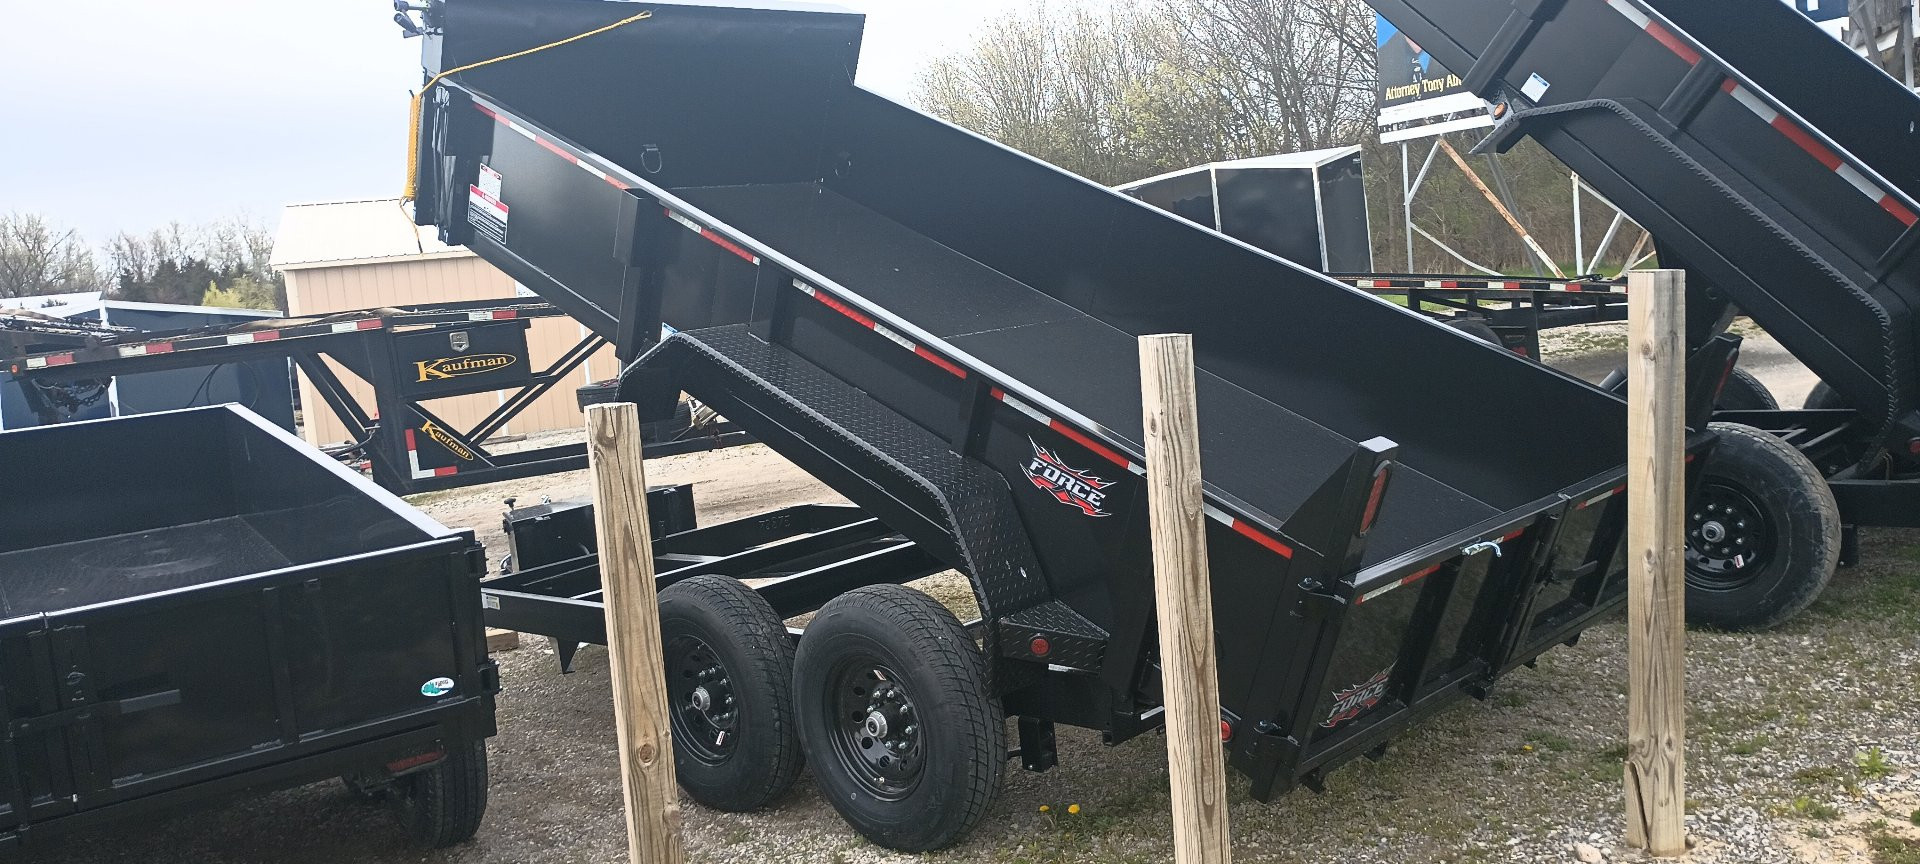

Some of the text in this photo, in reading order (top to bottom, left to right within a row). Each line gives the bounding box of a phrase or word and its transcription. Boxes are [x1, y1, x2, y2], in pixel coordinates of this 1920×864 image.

[1385, 83, 1421, 101] Attorney
[1421, 78, 1445, 92] Tony
[413, 357, 507, 382] Kaufman
[419, 420, 470, 459] Kaufman
[1029, 457, 1106, 507] FORCE
[1327, 676, 1390, 719] FORCE
